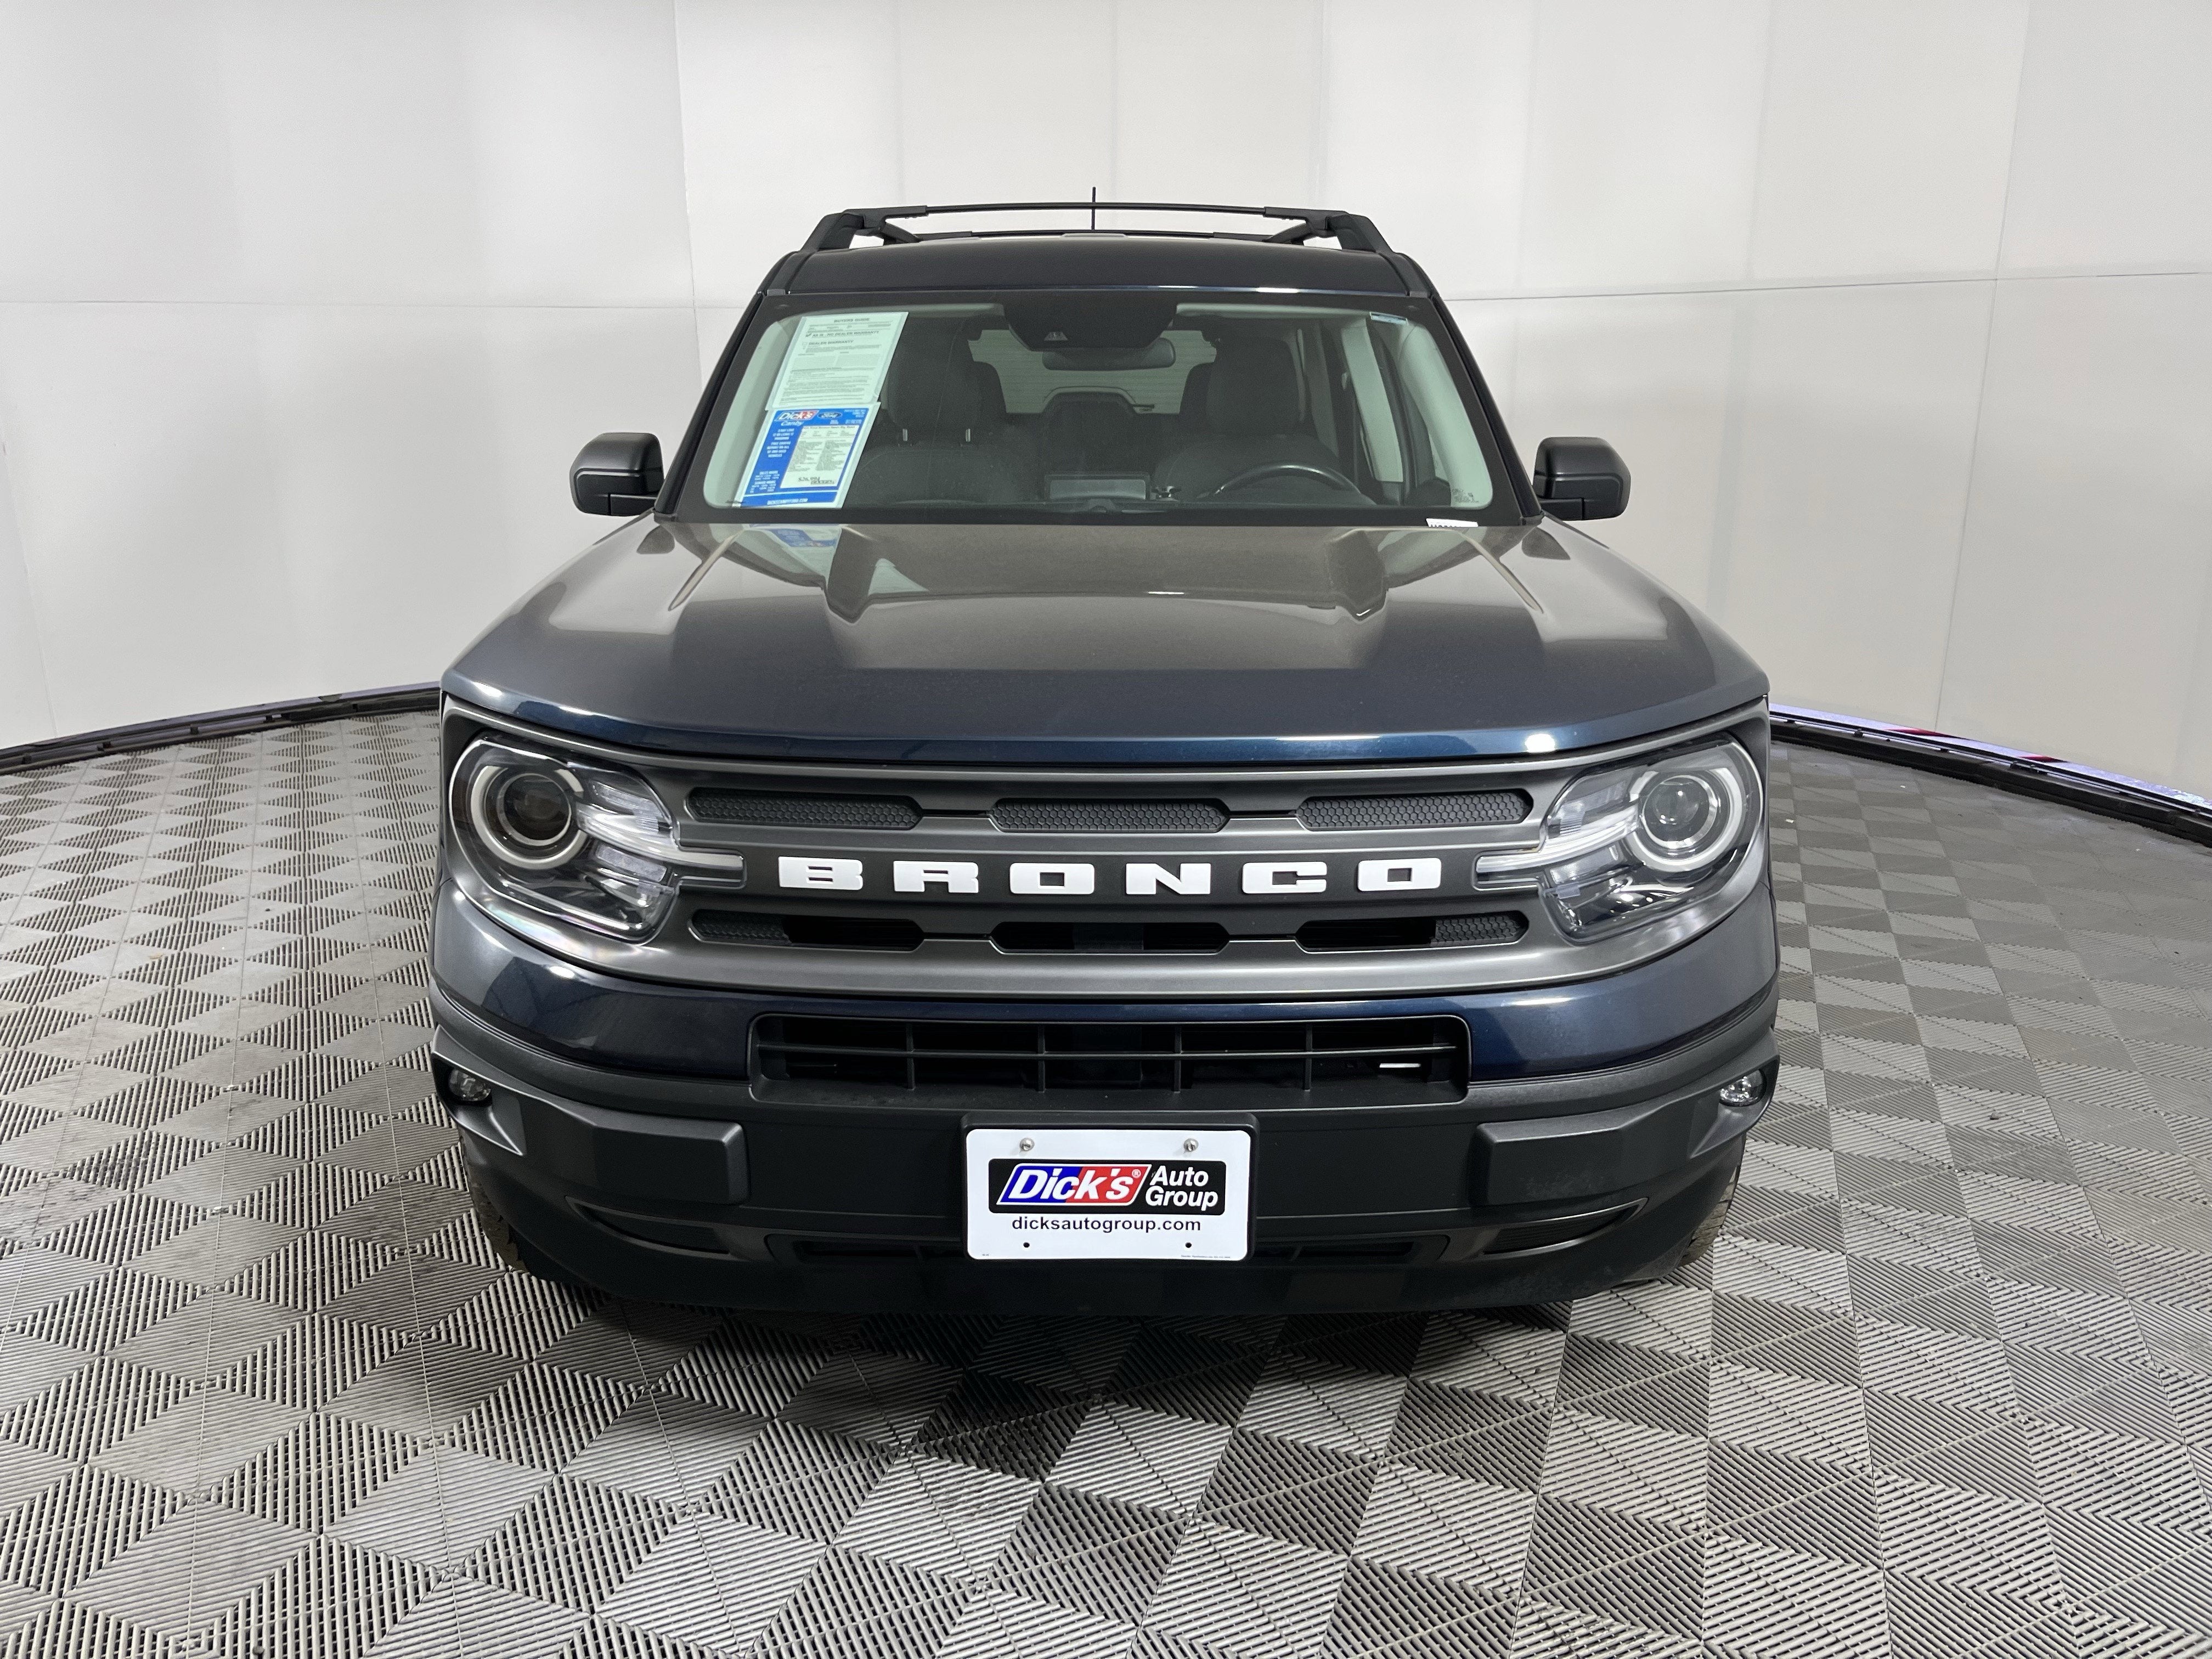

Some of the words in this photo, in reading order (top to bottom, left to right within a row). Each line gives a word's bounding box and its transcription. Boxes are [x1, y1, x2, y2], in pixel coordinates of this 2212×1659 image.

[778, 855, 1442, 896] BRONCO
[1008, 1167, 1134, 1200] Dick's
[1149, 1165, 1209, 1187] Auto
[1146, 1186, 1218, 1211] Group
[1012, 1216, 1201, 1233] dicksautogroup.com
